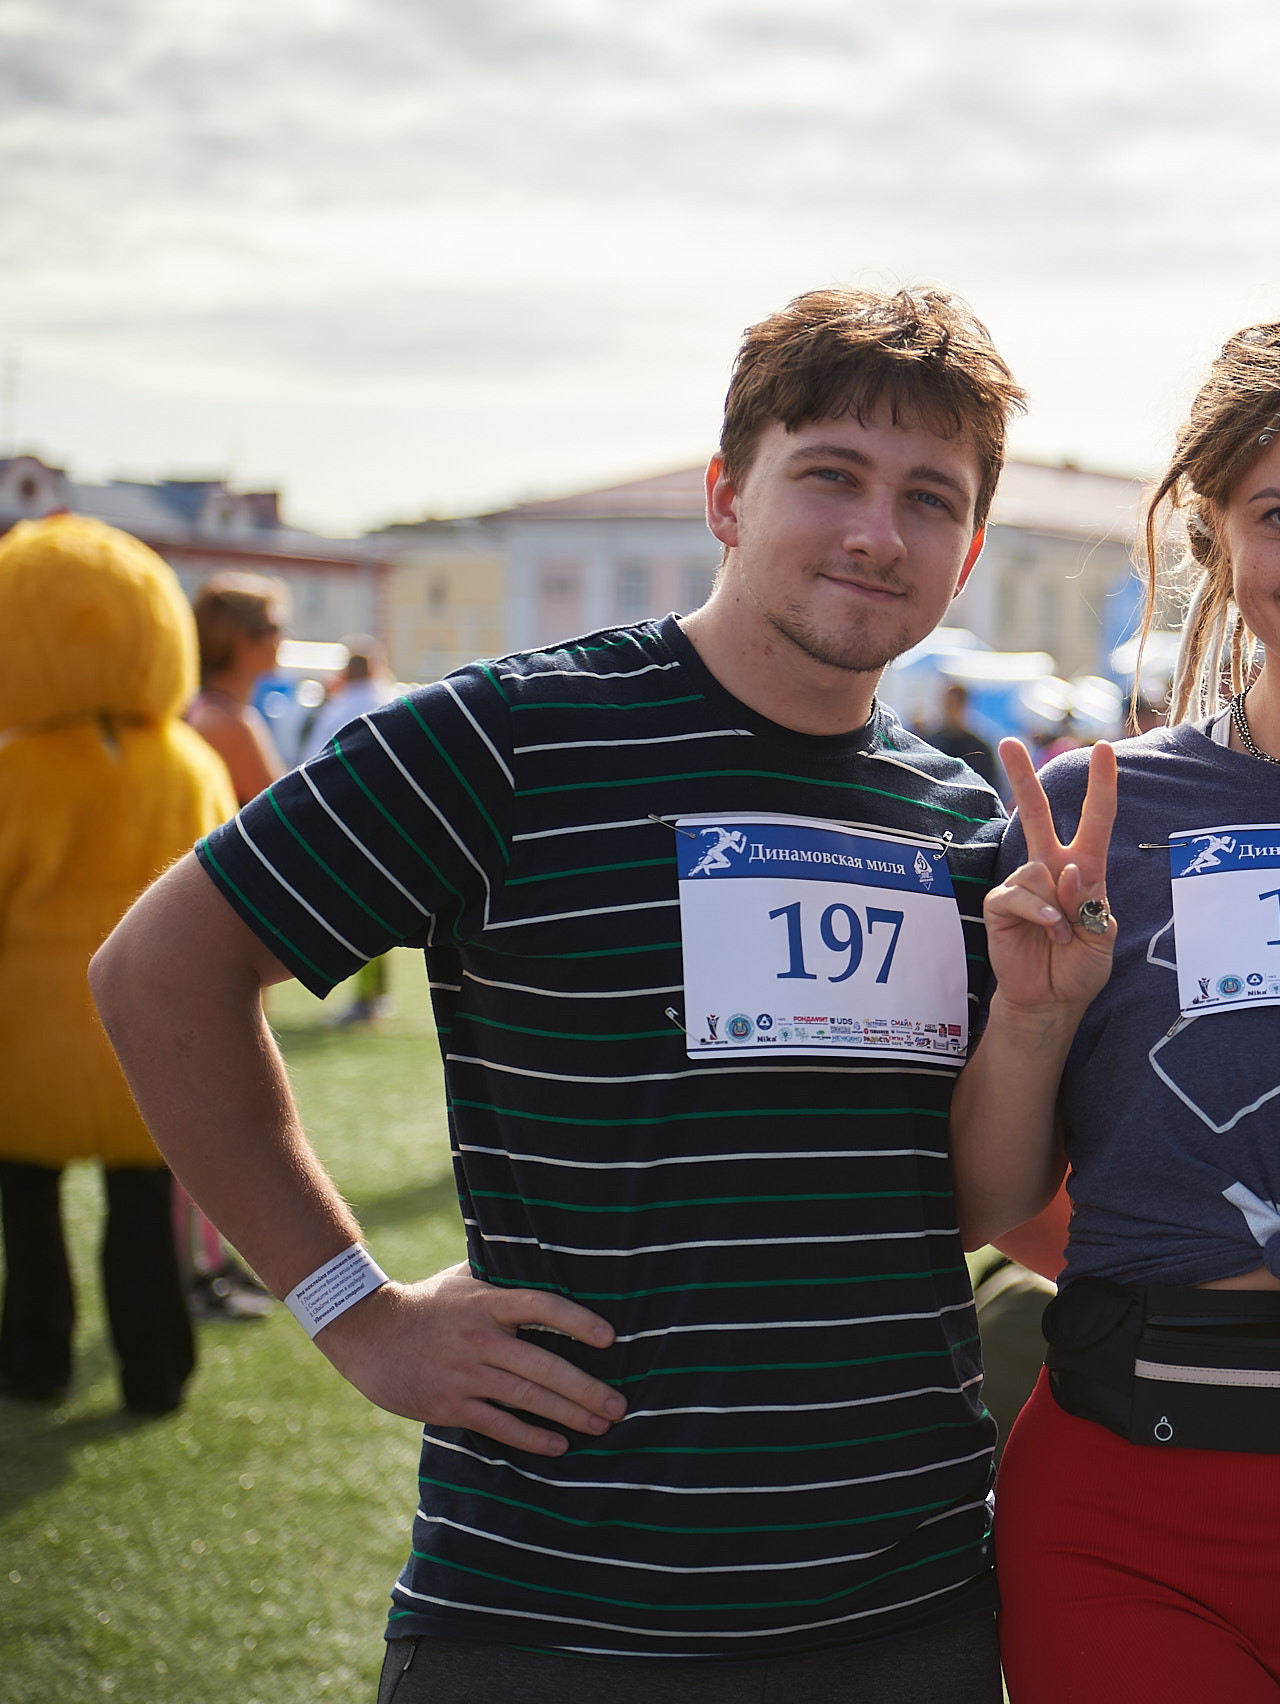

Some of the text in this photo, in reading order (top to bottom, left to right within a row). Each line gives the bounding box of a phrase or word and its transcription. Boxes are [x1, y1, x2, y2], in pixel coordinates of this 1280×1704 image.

[749, 843, 906, 876] Динамовская миля
[769, 900, 904, 984] 197
[837, 1017, 853, 1025] UDS
